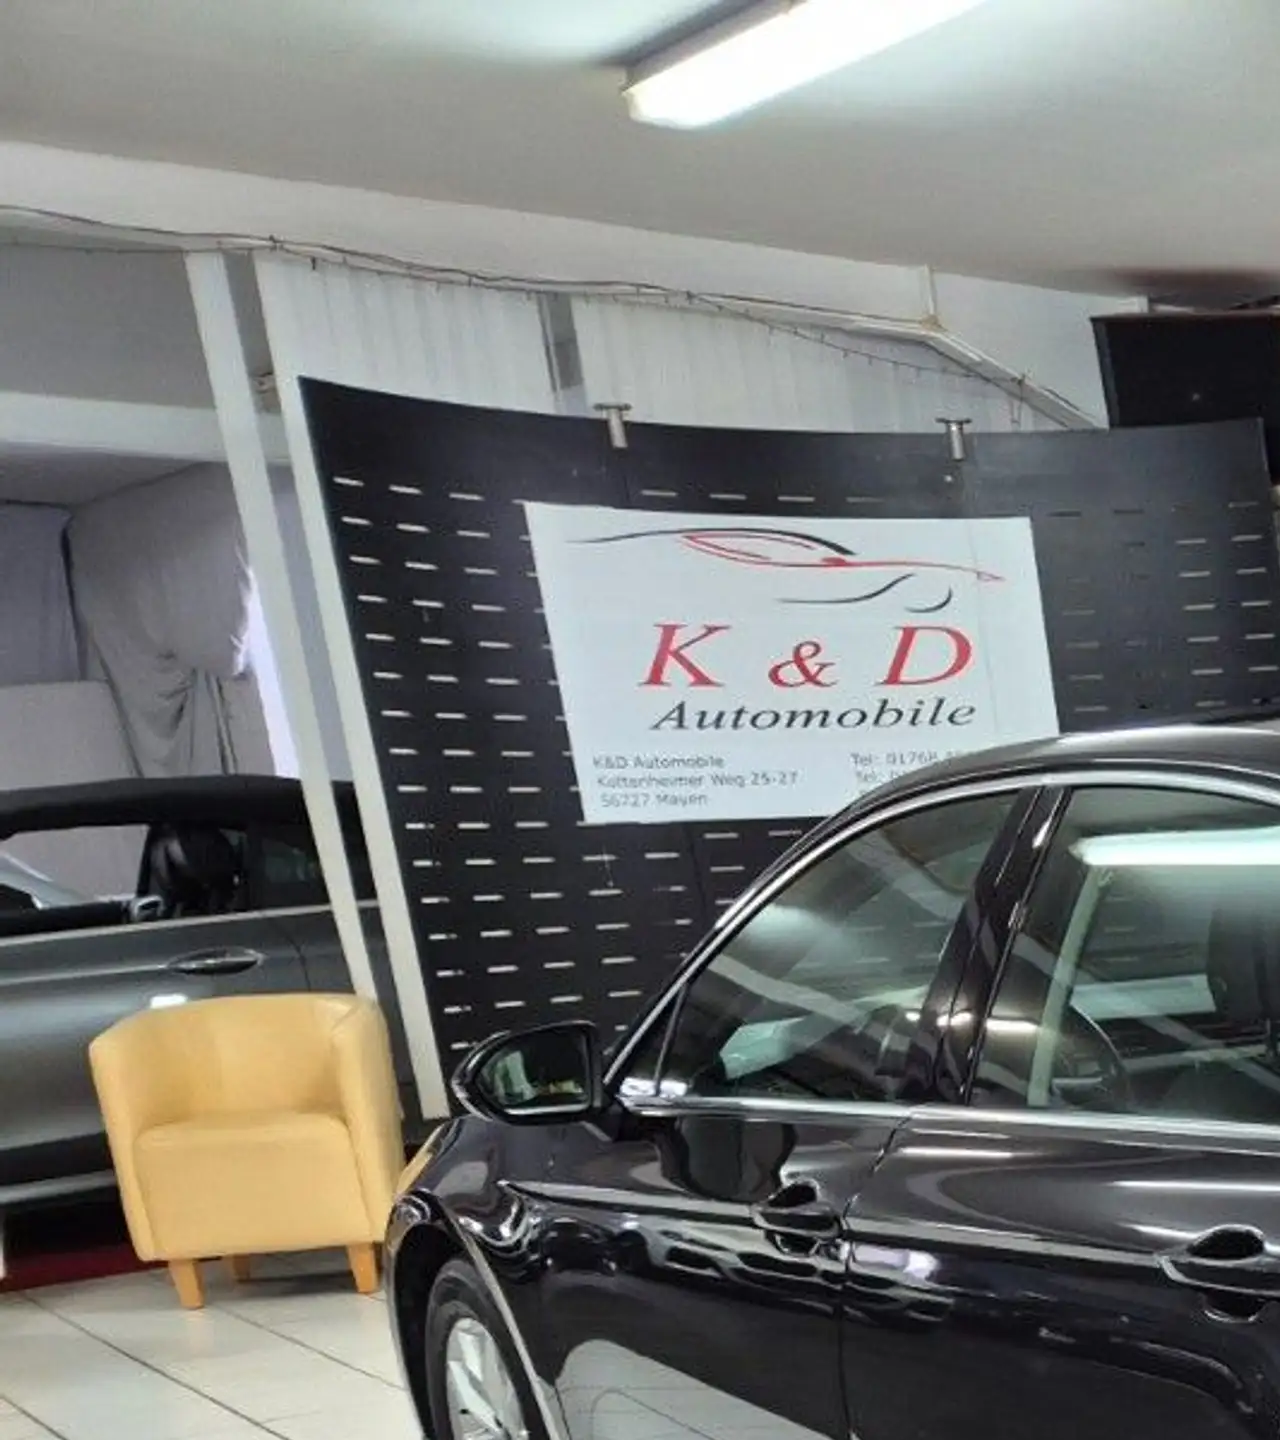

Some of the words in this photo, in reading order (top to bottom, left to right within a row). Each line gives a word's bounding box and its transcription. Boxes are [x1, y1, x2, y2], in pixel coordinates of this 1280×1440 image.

[637, 623, 731, 687] K
[767, 640, 841, 688] &
[876, 625, 973, 686] D
[649, 697, 977, 731] Automobile
[592, 755, 628, 769] K&D
[633, 754, 725, 769] Automobile
[709, 773, 746, 788] Weg
[655, 793, 709, 808] Mayen
